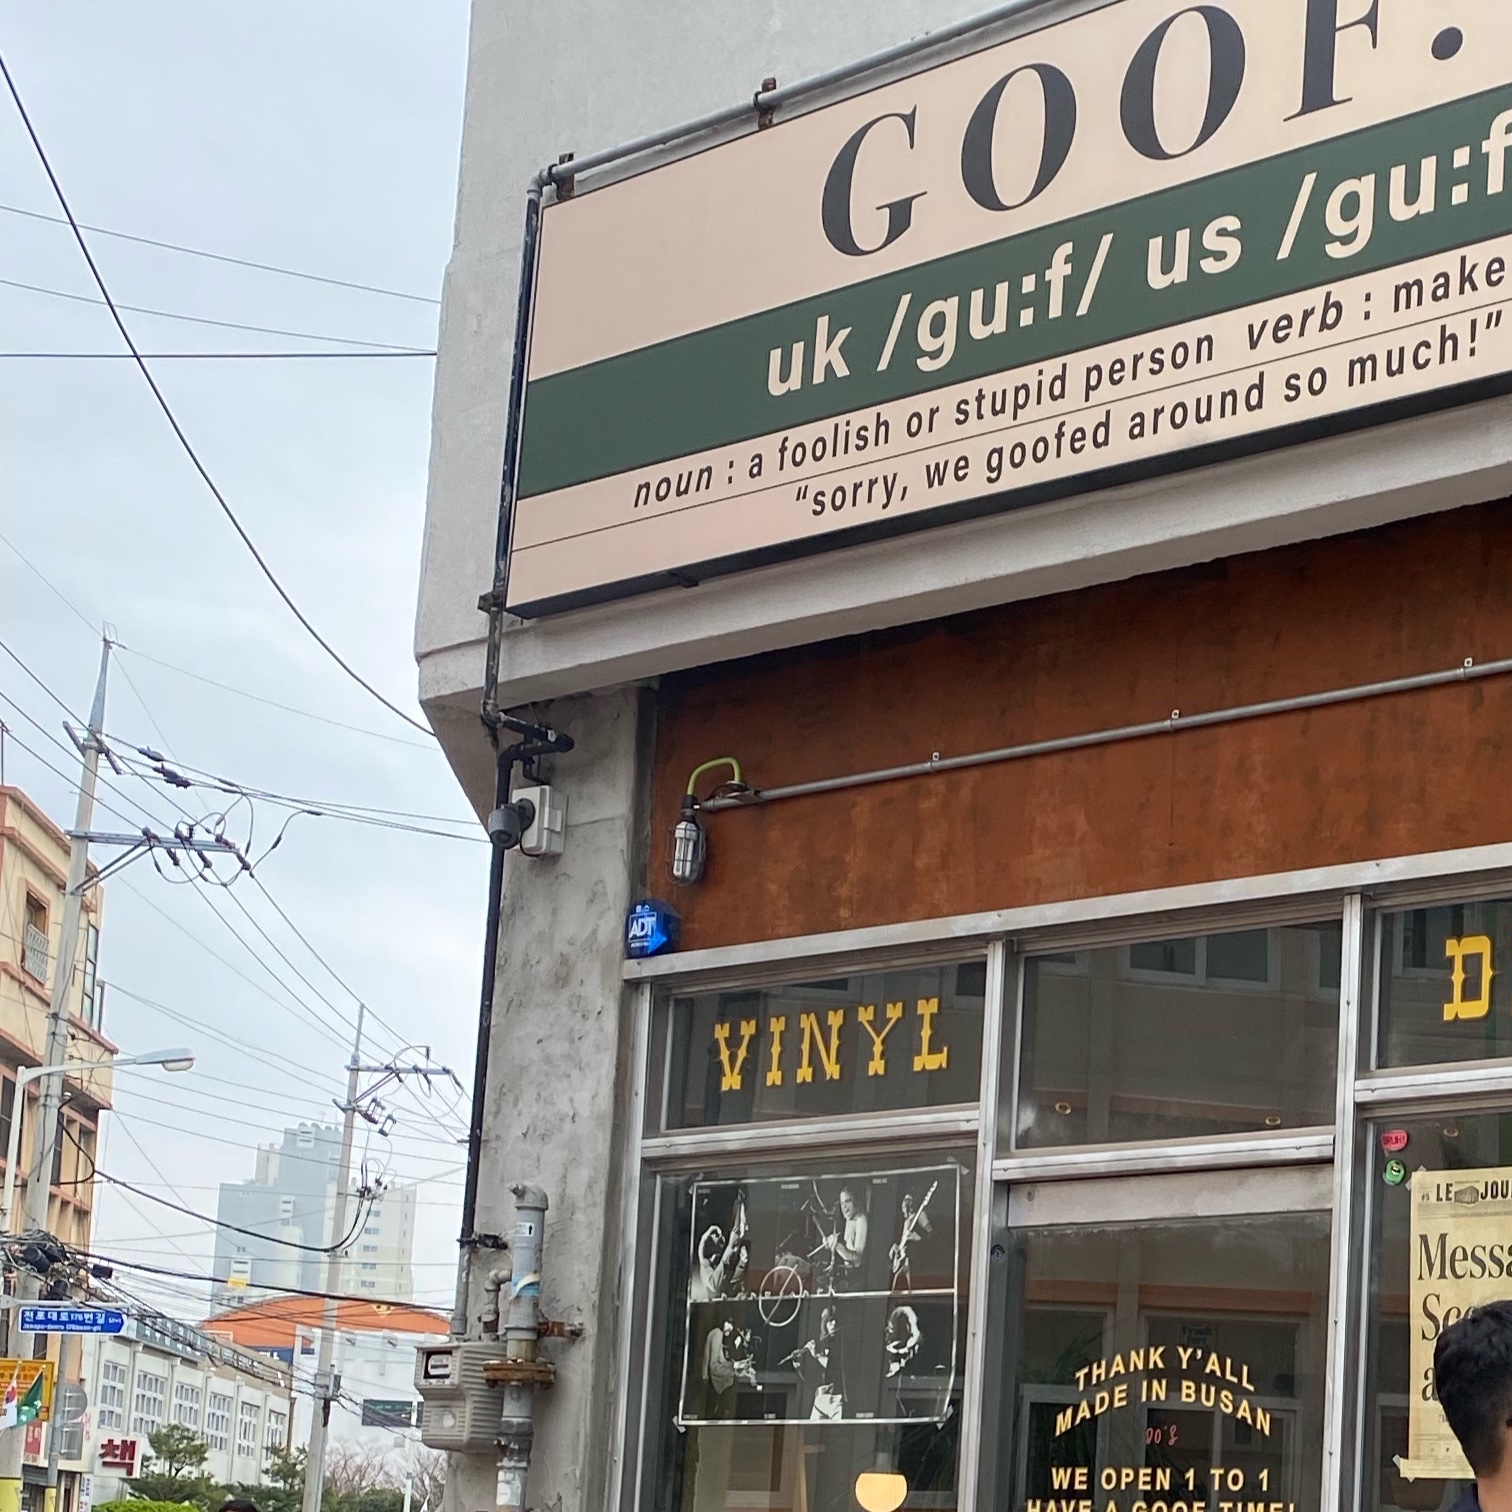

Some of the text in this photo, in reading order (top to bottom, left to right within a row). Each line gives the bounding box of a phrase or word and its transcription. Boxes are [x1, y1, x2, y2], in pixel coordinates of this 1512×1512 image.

[820, 0, 1464, 257] GOOF.
[766, 315, 852, 397] uk
[877, 232, 1114, 373] /gu:f/
[1144, 214, 1244, 290] us
[633, 470, 714, 508] noun
[747, 456, 764, 480] a
[777, 413, 891, 473] foolish
[905, 407, 940, 440] or
[954, 363, 1067, 424] stupid
[1084, 330, 1214, 401] person
[1247, 291, 1343, 351] verb
[1392, 254, 1506, 315] make
[925, 459, 970, 490] we
[985, 410, 1111, 485] goofed
[1127, 373, 1265, 440] around
[1283, 366, 1328, 403] so
[629, 917, 656, 938] ADT
[714, 997, 949, 1091] VINYL
[1436, 1182, 1454, 1202] LE
[1074, 1345, 1167, 1393] THANK
[1054, 1378, 1271, 1438] MADE IN BUSAN
[98, 1438, 137, 1477] 책
[1051, 1466, 1270, 1492] WE OPEN 1 TO 1
